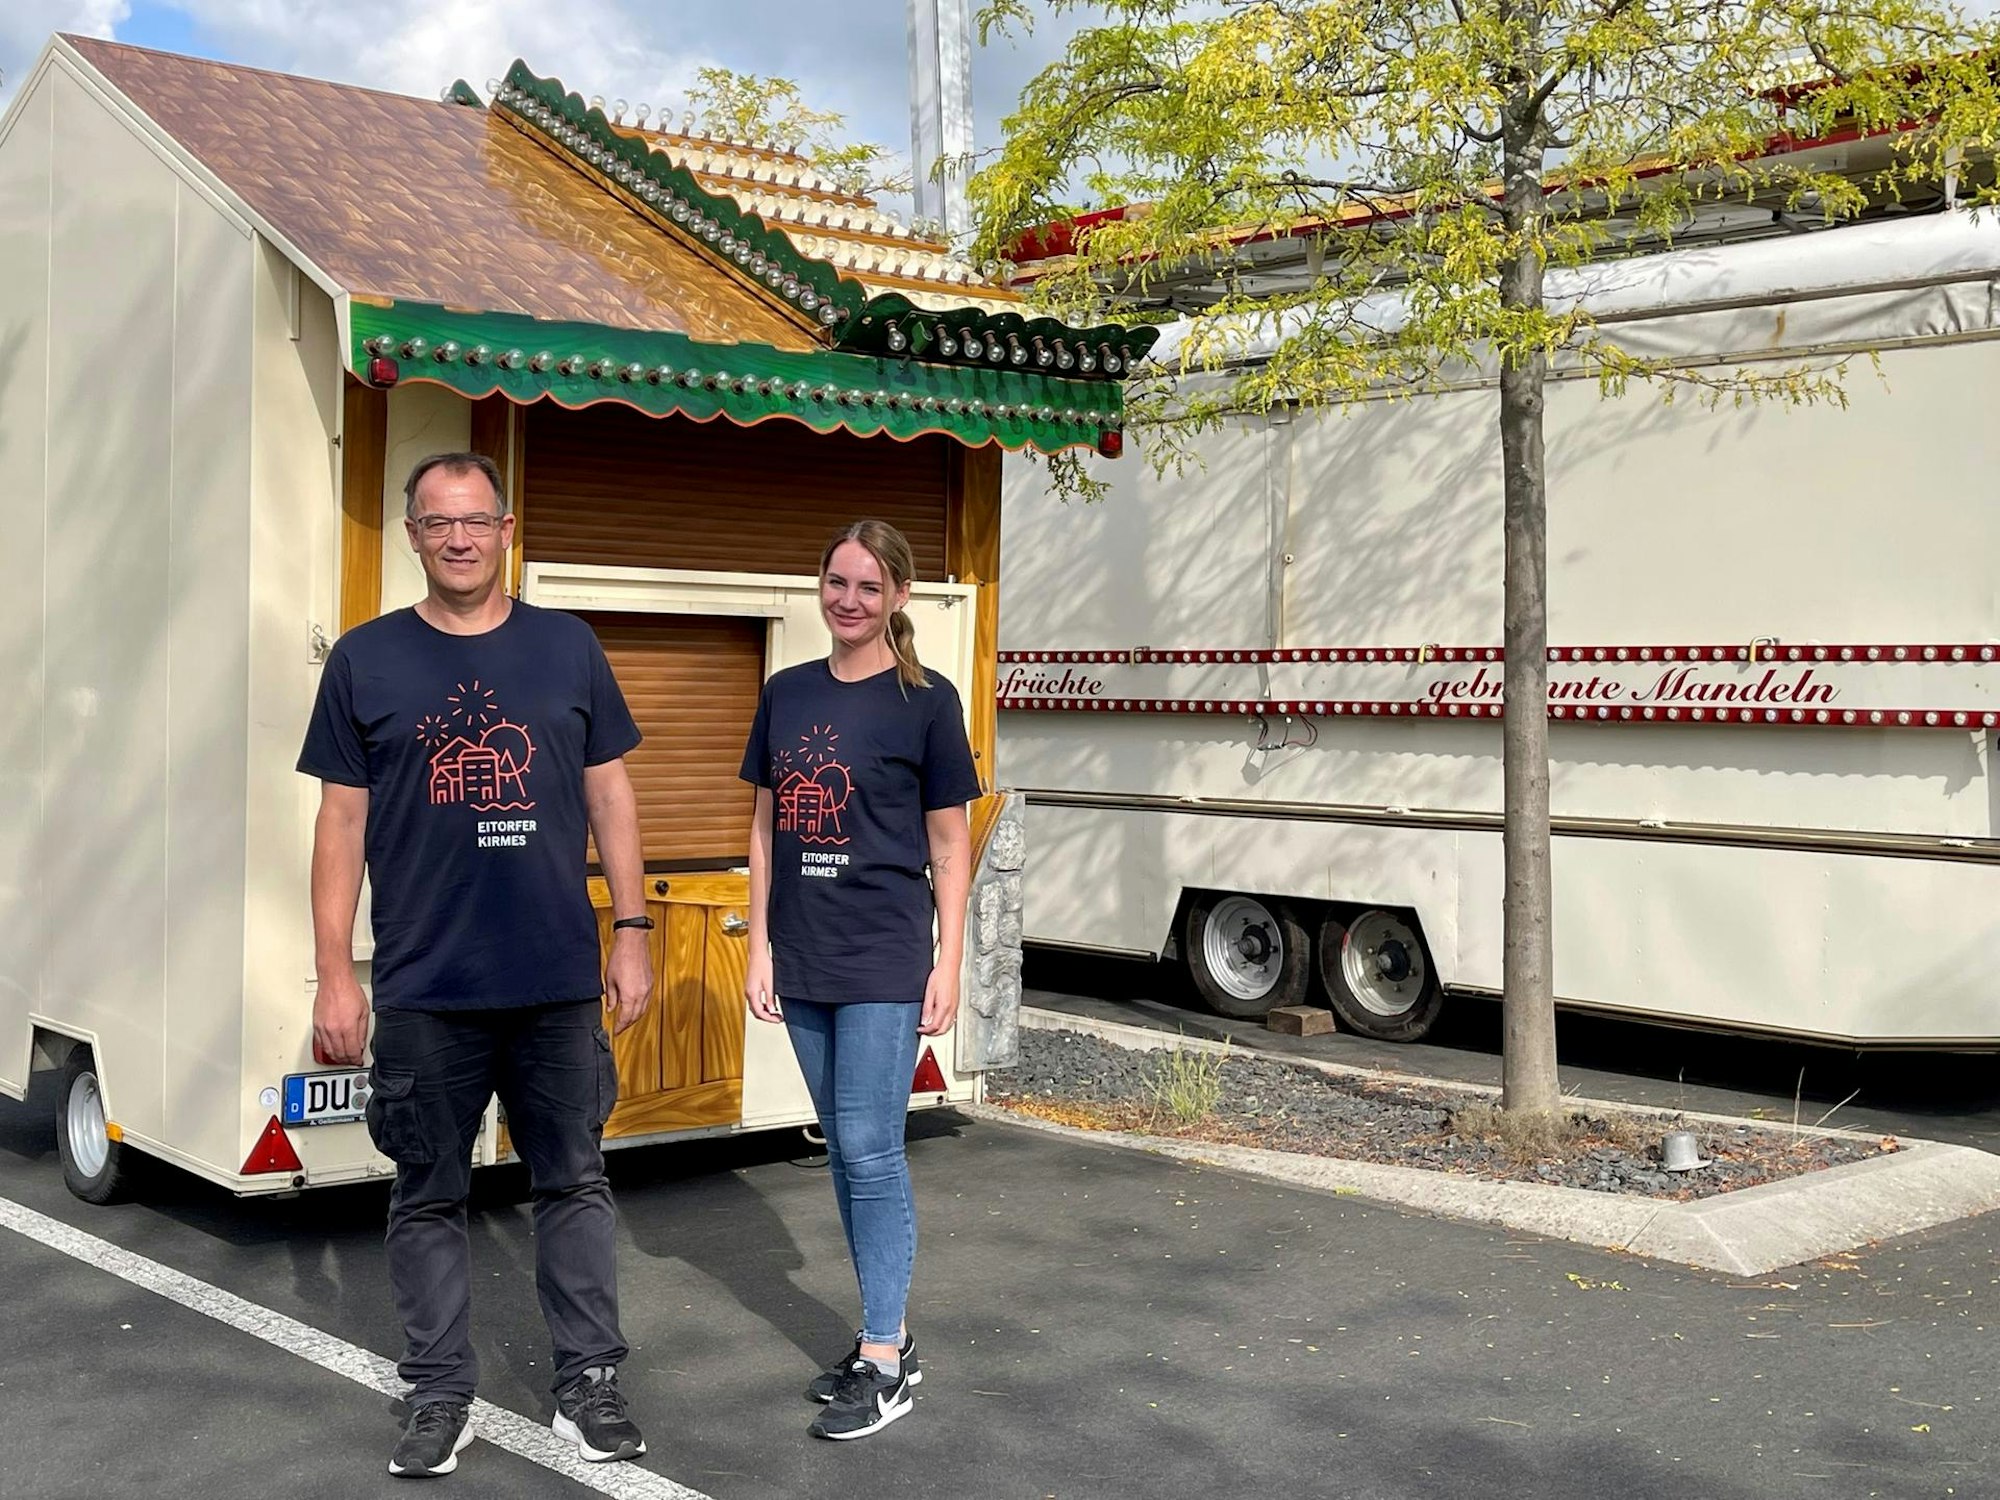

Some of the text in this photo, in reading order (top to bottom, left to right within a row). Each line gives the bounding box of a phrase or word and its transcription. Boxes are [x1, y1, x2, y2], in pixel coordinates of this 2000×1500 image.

[1417, 667, 1841, 703] gebrnnte Mandeln
[477, 820, 537, 833] EITORFER
[477, 835, 527, 848] KIRMES
[801, 852, 849, 865] EITORFER
[801, 866, 838, 877] KIRMES
[291, 1079, 350, 1113] D DU
